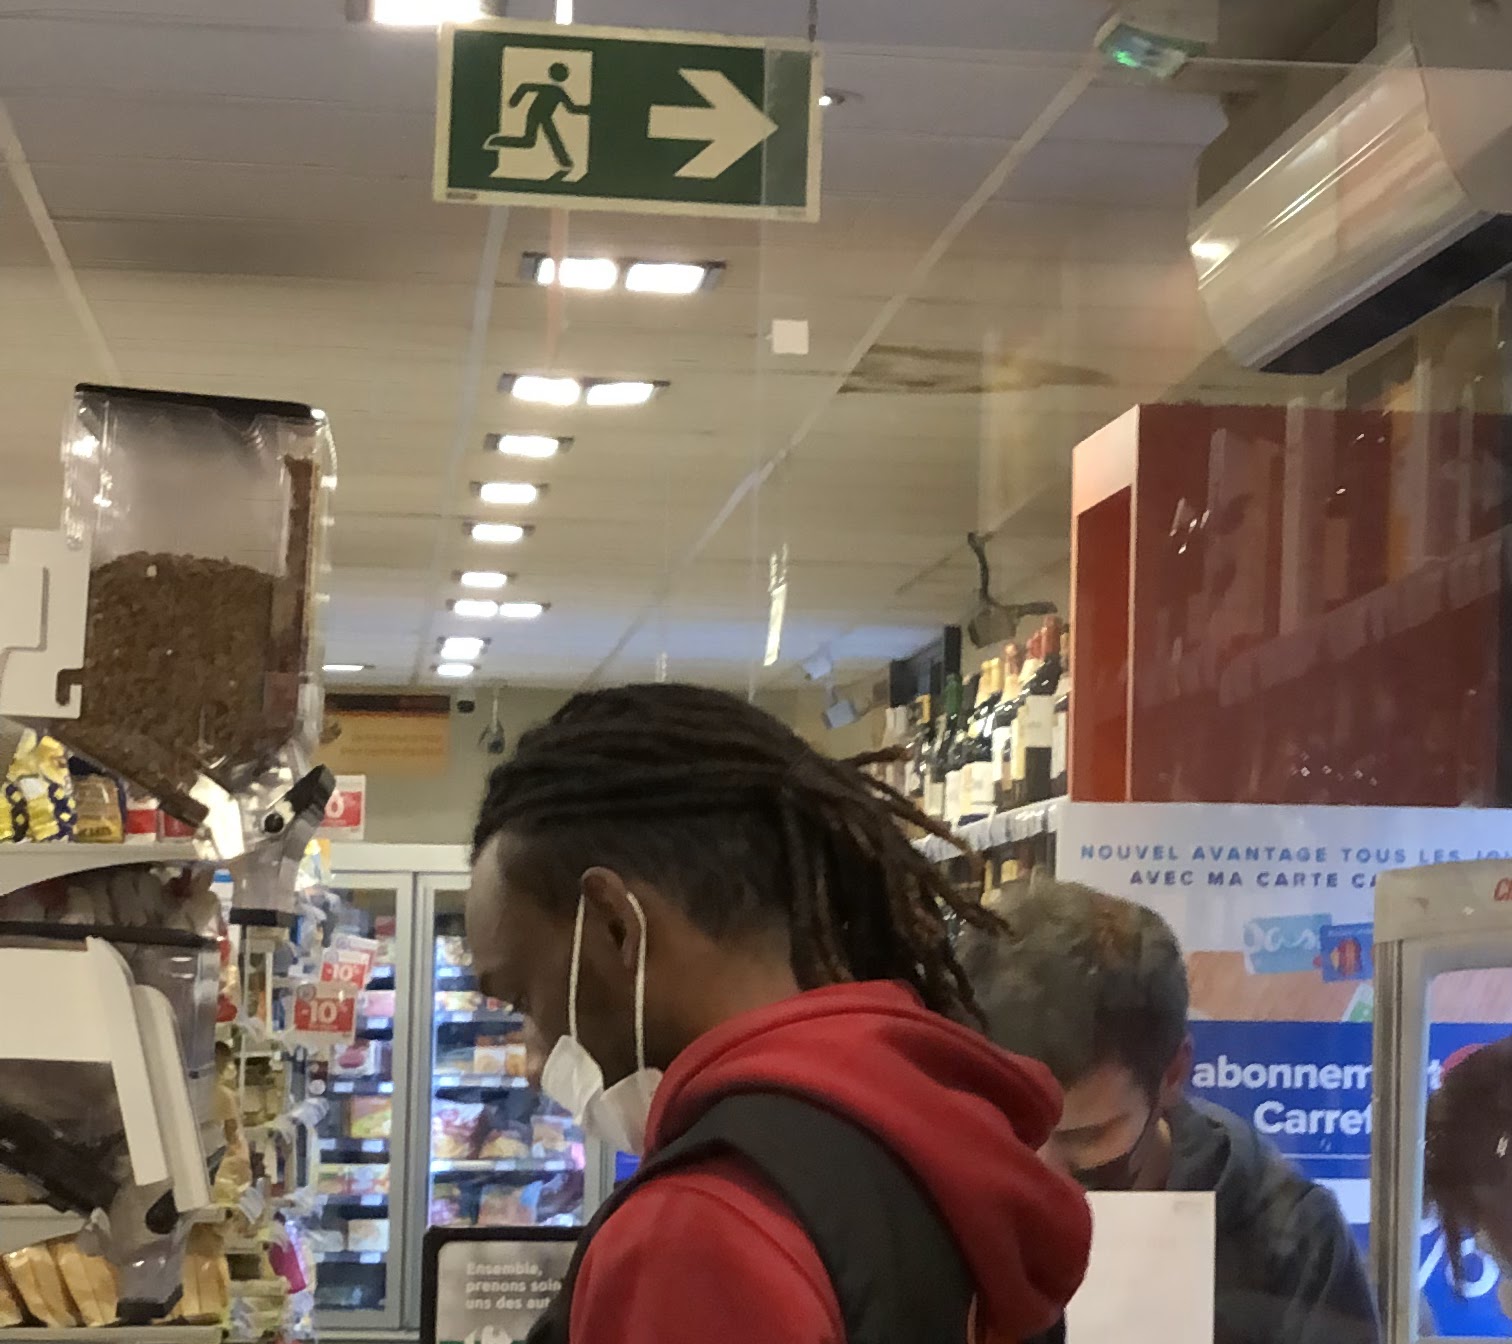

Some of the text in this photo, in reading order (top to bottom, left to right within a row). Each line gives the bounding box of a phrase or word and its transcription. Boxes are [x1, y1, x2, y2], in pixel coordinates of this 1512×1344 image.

[1080, 844, 1178, 862] NOUVEL
[1191, 845, 1327, 863] AVANTAGE
[1342, 847, 1406, 864] TOUS
[1130, 870, 1194, 886] AVEC
[1207, 871, 1244, 887] MA
[1256, 871, 1338, 889] CARTE
[465, 1261, 543, 1278] Ensemble,
[465, 1280, 527, 1294] prenons
[465, 1298, 491, 1310] uns
[496, 1295, 522, 1310] des
